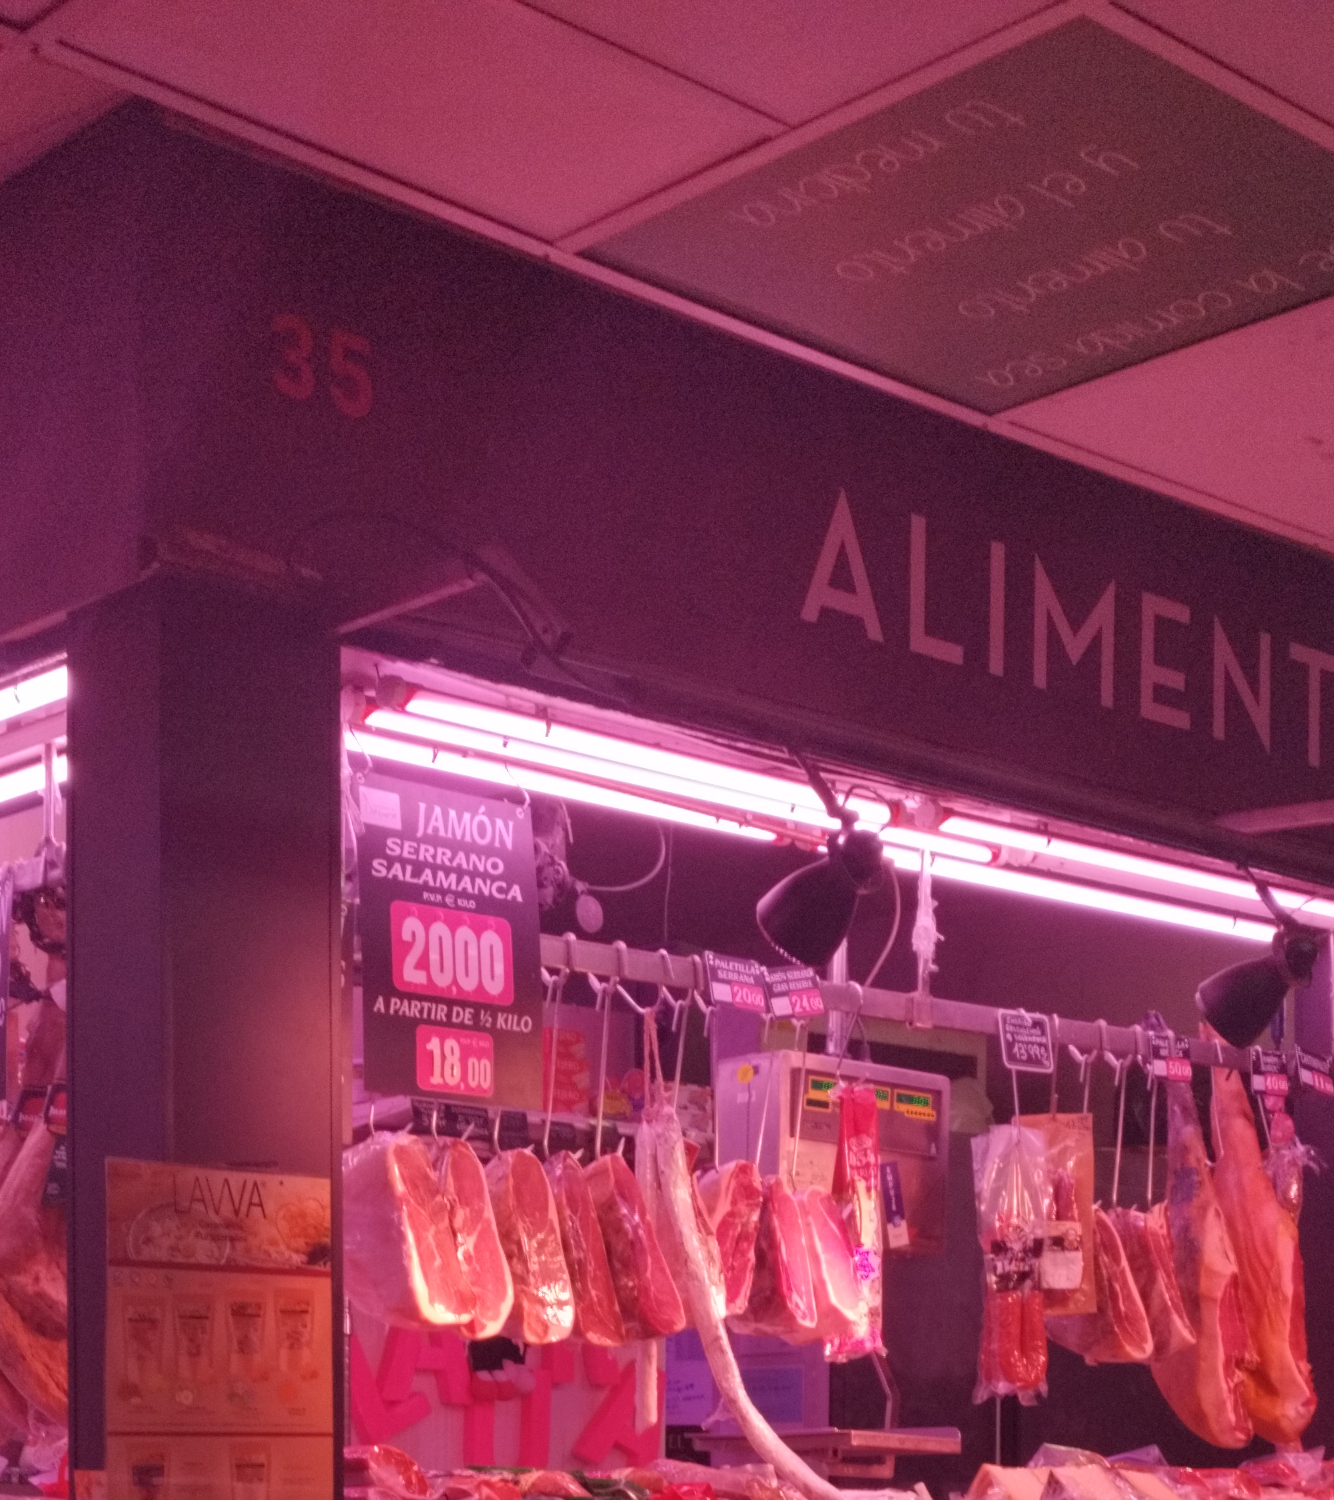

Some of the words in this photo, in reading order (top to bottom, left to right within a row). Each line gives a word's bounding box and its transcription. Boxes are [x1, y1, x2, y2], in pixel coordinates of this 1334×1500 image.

[270, 312, 374, 420] 35
[415, 802, 515, 850] JAMÓN
[370, 857, 524, 903] SALAMANCA
[385, 837, 505, 877] SERRANO
[373, 996, 386, 1013] A
[389, 998, 449, 1021] PARTIR
[452, 1006, 473, 1025] DE
[497, 1012, 533, 1034] KILO
